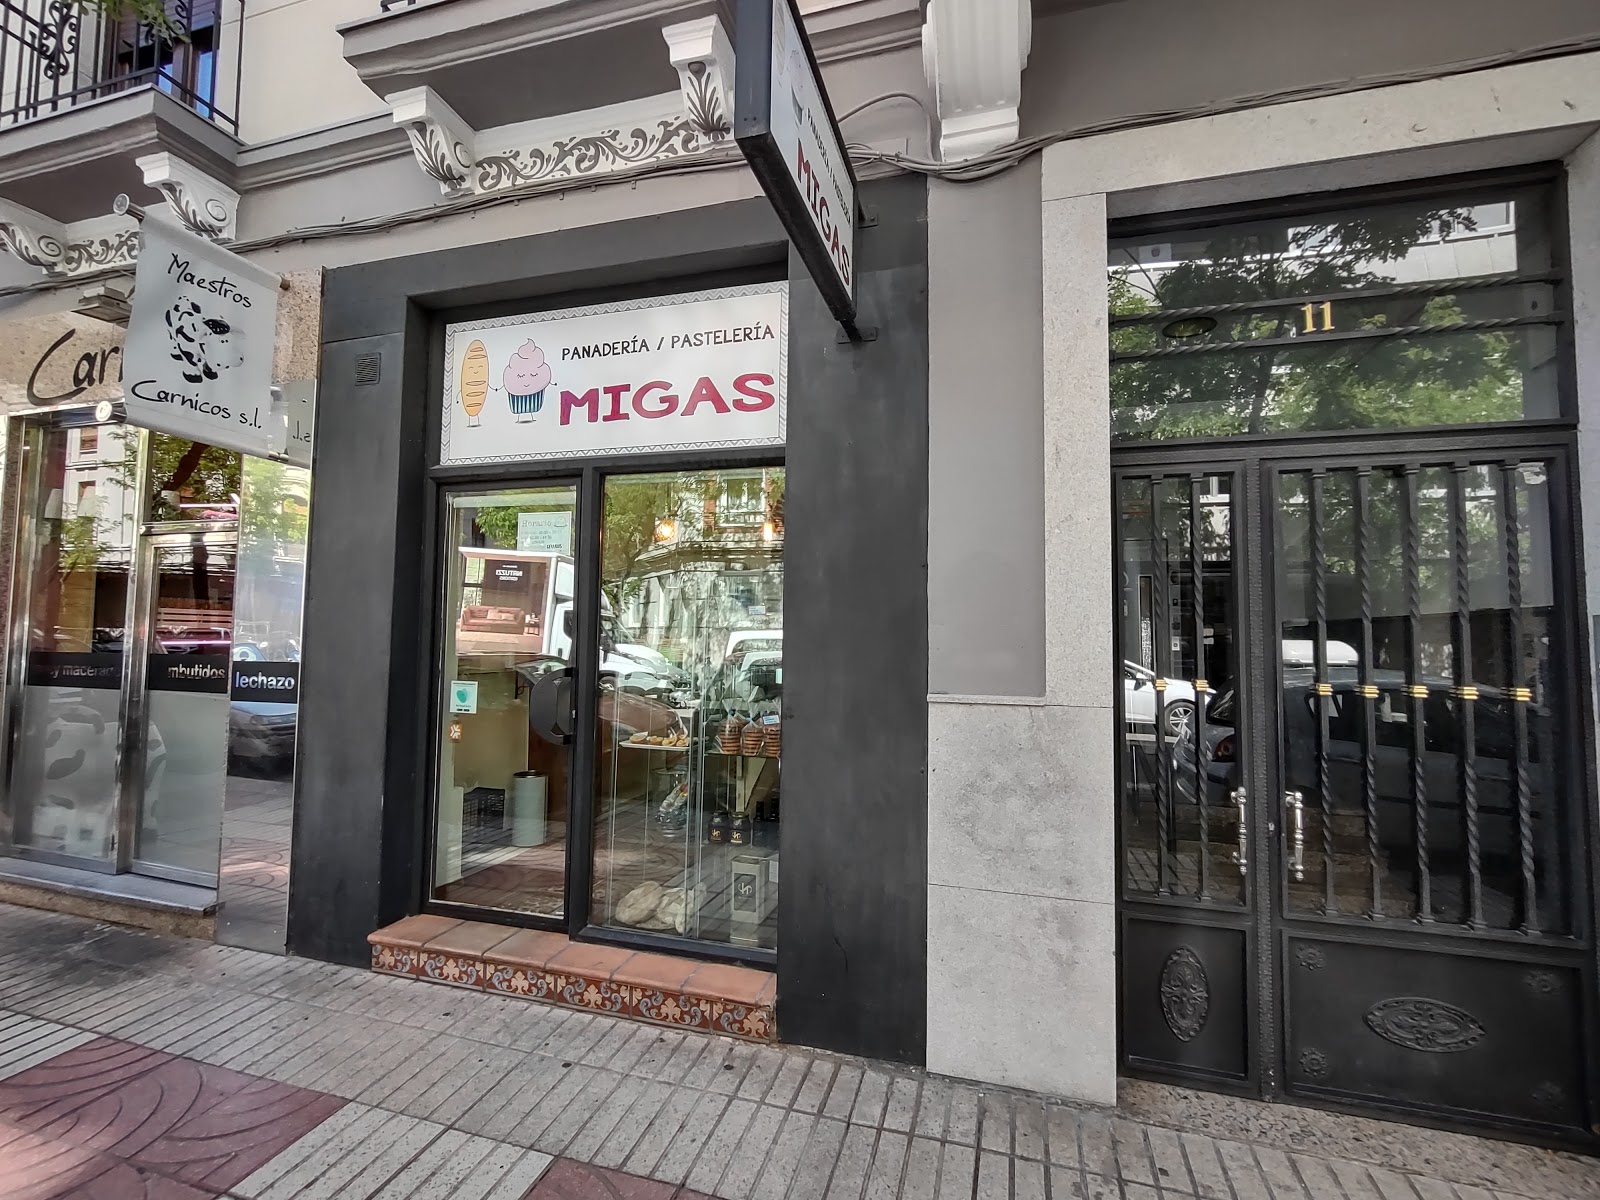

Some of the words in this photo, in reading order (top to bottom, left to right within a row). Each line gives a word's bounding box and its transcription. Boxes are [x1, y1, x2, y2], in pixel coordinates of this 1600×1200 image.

[797, 137, 851, 287] MIGAS
[167, 253, 252, 308] Maestros
[1301, 301, 1335, 334] 11
[561, 335, 650, 361] PANADERÍA
[656, 336, 664, 351] /
[670, 322, 775, 349] PASTELERÍA
[131, 380, 231, 419] Carnicos
[239, 407, 262, 430] s.l.
[559, 373, 776, 426] MIGAS
[167, 662, 226, 680] mbutidos
[235, 670, 295, 691] lechazo
